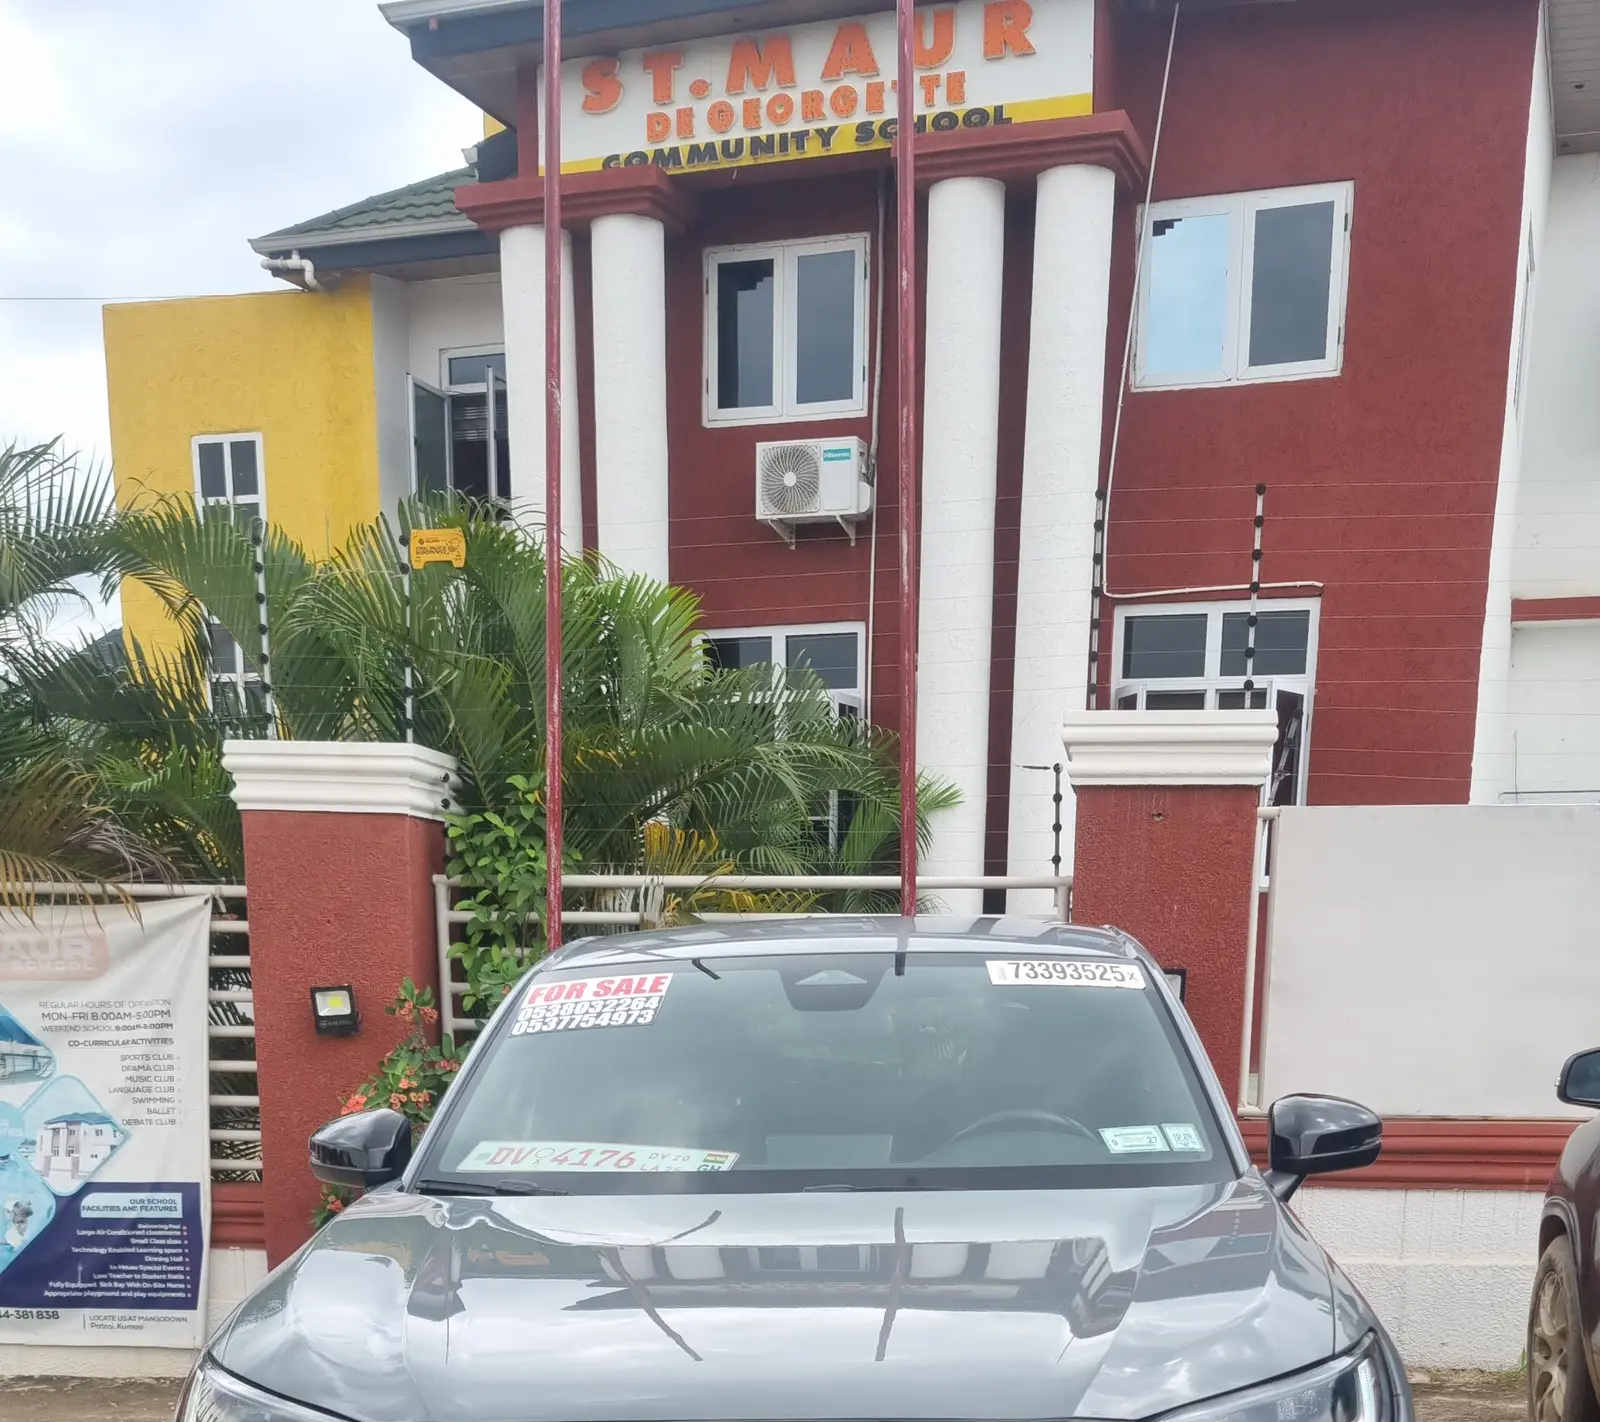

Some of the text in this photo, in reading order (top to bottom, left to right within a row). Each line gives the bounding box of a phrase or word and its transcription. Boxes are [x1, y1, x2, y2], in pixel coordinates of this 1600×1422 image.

[581, 0, 1037, 115] ST. MAUR
[646, 71, 966, 143] DE GEORGETE
[602, 105, 1012, 170] COMMUNITY SCHOOL
[528, 975, 668, 1004] FOR SALE
[39, 1000, 79, 1009] REGULAR
[81, 1000, 113, 1009] HOURS
[114, 1000, 125, 1008] OF
[517, 996, 660, 1022] 0538032264
[41, 1012, 89, 1021] MON-FRI
[511, 1009, 654, 1035] 0537754973
[41, 1025, 82, 1033] WEEKEND
[83, 1024, 114, 1032] SCHOOL
[130, 1037, 174, 1045] ACTIVITIES
[125, 1075, 152, 1083] MUSIC
[108, 1086, 153, 1094] LANGUAGE
[147, 1107, 175, 1115] BALLET
[155, 1118, 176, 1126] CLUB
[550, 1149, 636, 1169] 4176
[71, 1246, 107, 1254] Technology
[139, 1264, 162, 1272] Special
[84, 1290, 119, 1298] playground
[36, 1310, 60, 1320] 838
[116, 1322, 144, 1330] Kumasi
